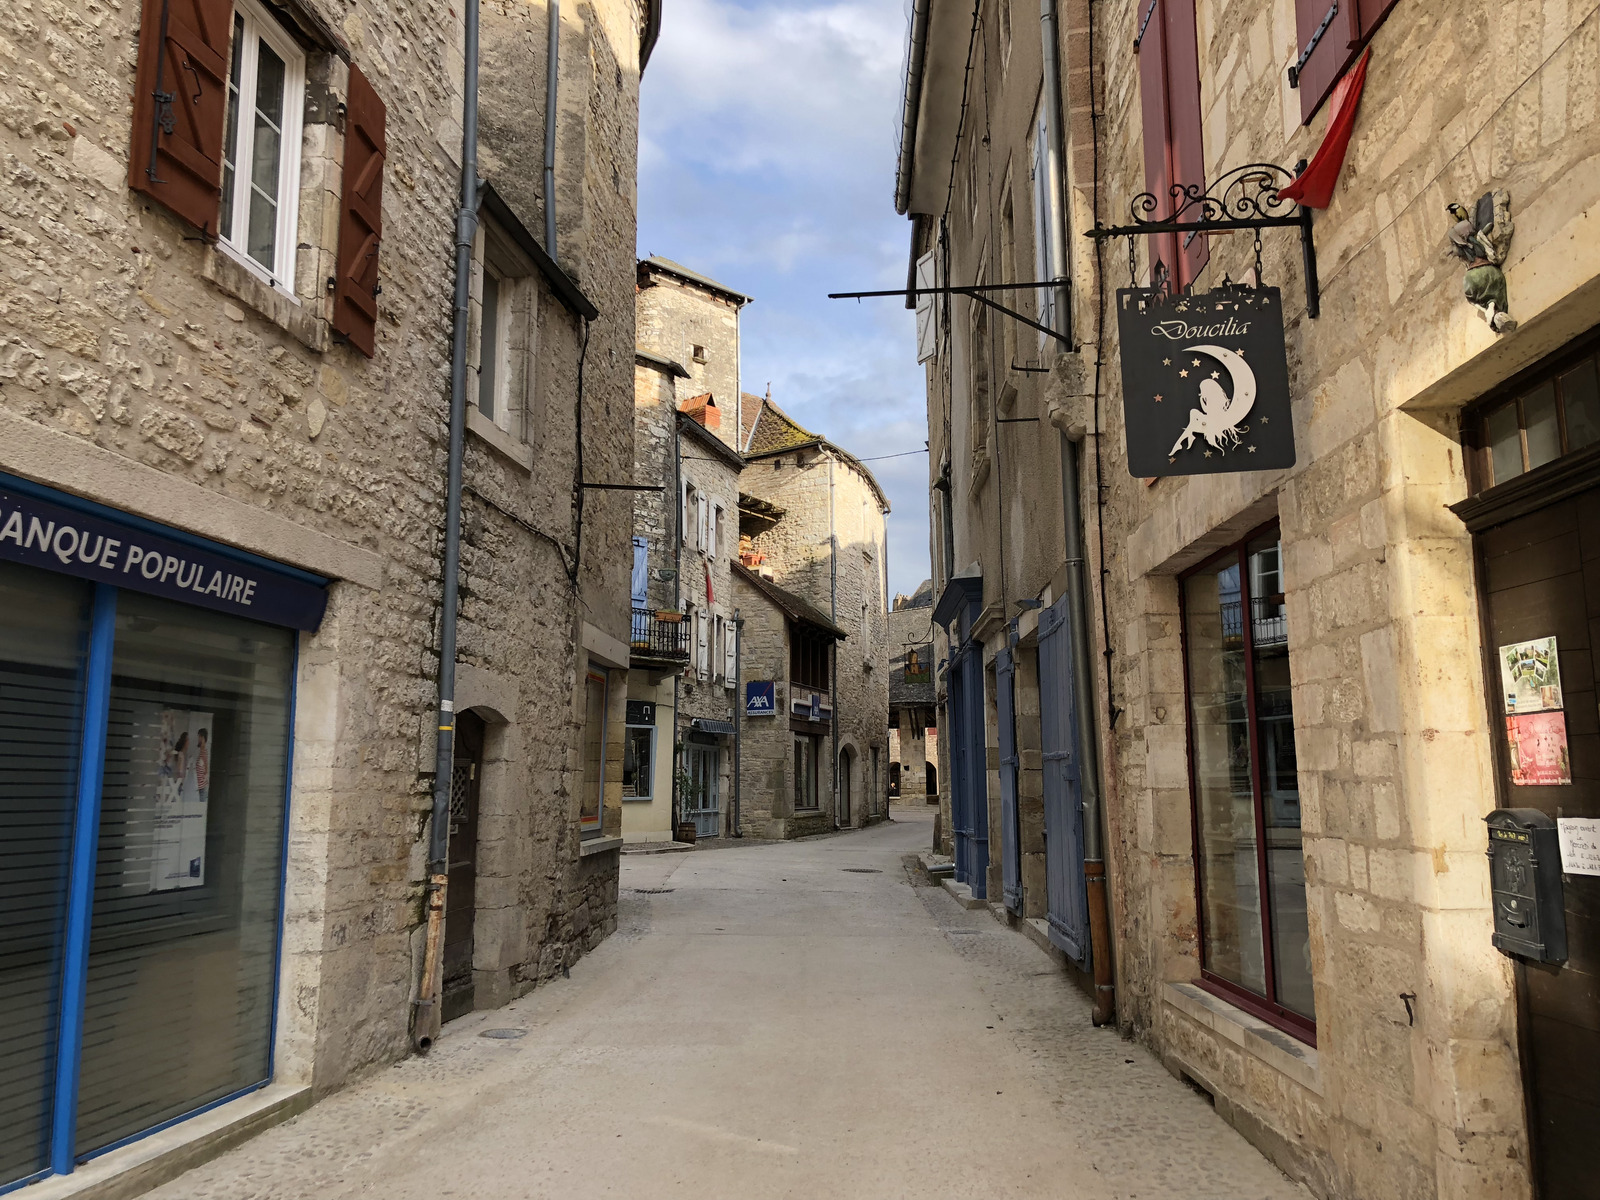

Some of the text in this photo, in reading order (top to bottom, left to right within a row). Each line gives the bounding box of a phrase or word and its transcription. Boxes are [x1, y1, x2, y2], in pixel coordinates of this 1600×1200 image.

[1151, 317, 1252, 340] Doucilia
[0, 508, 258, 605] ANQUE POPULAIRE
[747, 695, 769, 708] AXA
